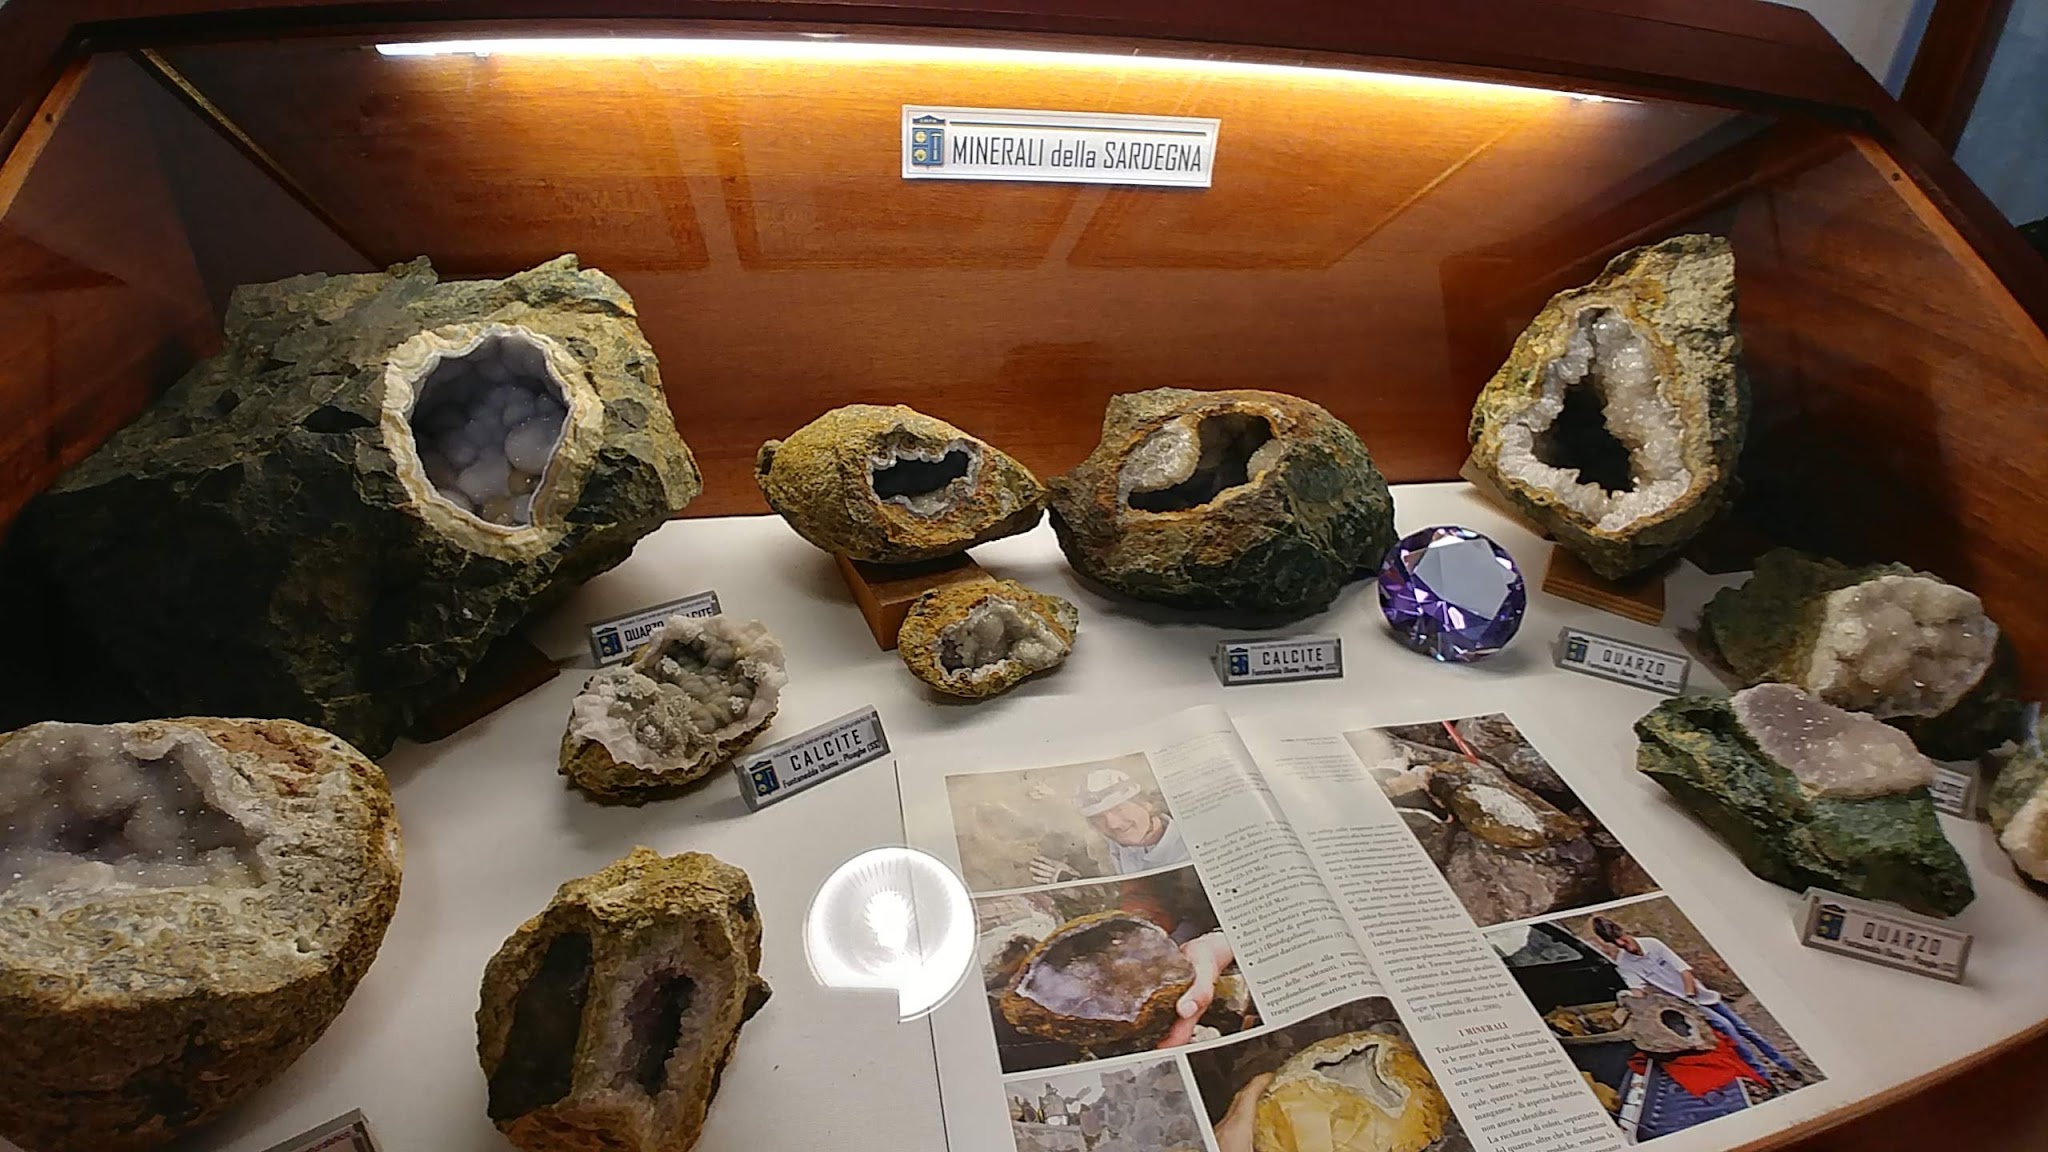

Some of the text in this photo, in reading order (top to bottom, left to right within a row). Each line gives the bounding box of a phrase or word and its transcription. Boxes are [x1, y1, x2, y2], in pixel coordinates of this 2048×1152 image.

[952, 135, 1201, 172] MINERALI della SARDEGNA
[1262, 647, 1322, 666] CALCITE
[1602, 649, 1666, 676] QUARZO
[790, 729, 862, 771] CALCITE
[1862, 921, 1942, 956] QUARZO
[1458, 1022, 1508, 1037] I MINERALI
[1487, 1136, 1500, 1144] La
[1500, 1127, 1533, 1141] ricchezza
[1533, 1123, 1541, 1132] di
